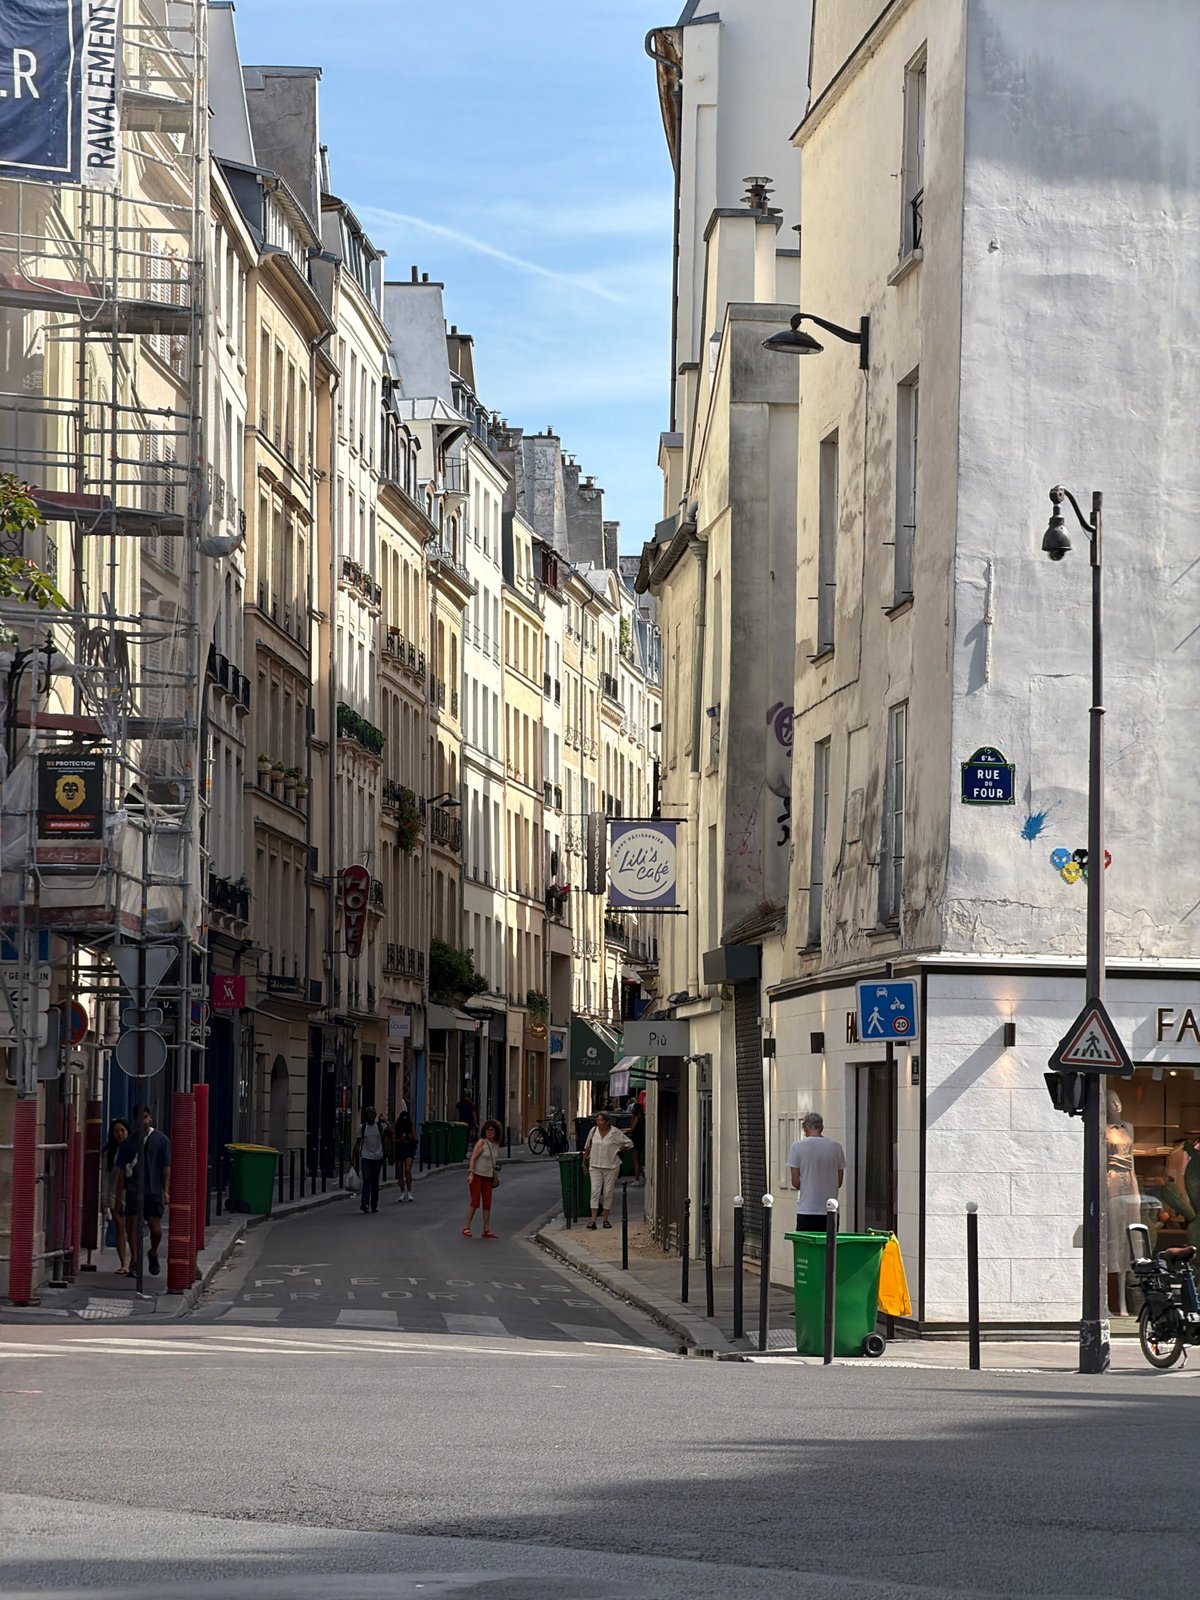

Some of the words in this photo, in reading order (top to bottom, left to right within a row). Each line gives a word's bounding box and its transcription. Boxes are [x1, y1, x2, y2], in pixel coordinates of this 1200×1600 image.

[87, 3, 116, 169] RAVALEMENT
[977, 769, 1000, 779] RUE
[973, 788, 1004, 798] FOUR
[614, 841, 627, 858] HAPPY
[618, 846, 658, 874] Lili's
[636, 860, 670, 884] café
[345, 875, 366, 956] HOTEL
[896, 1021, 907, 1029] 20
[649, 1032, 667, 1046] Più
